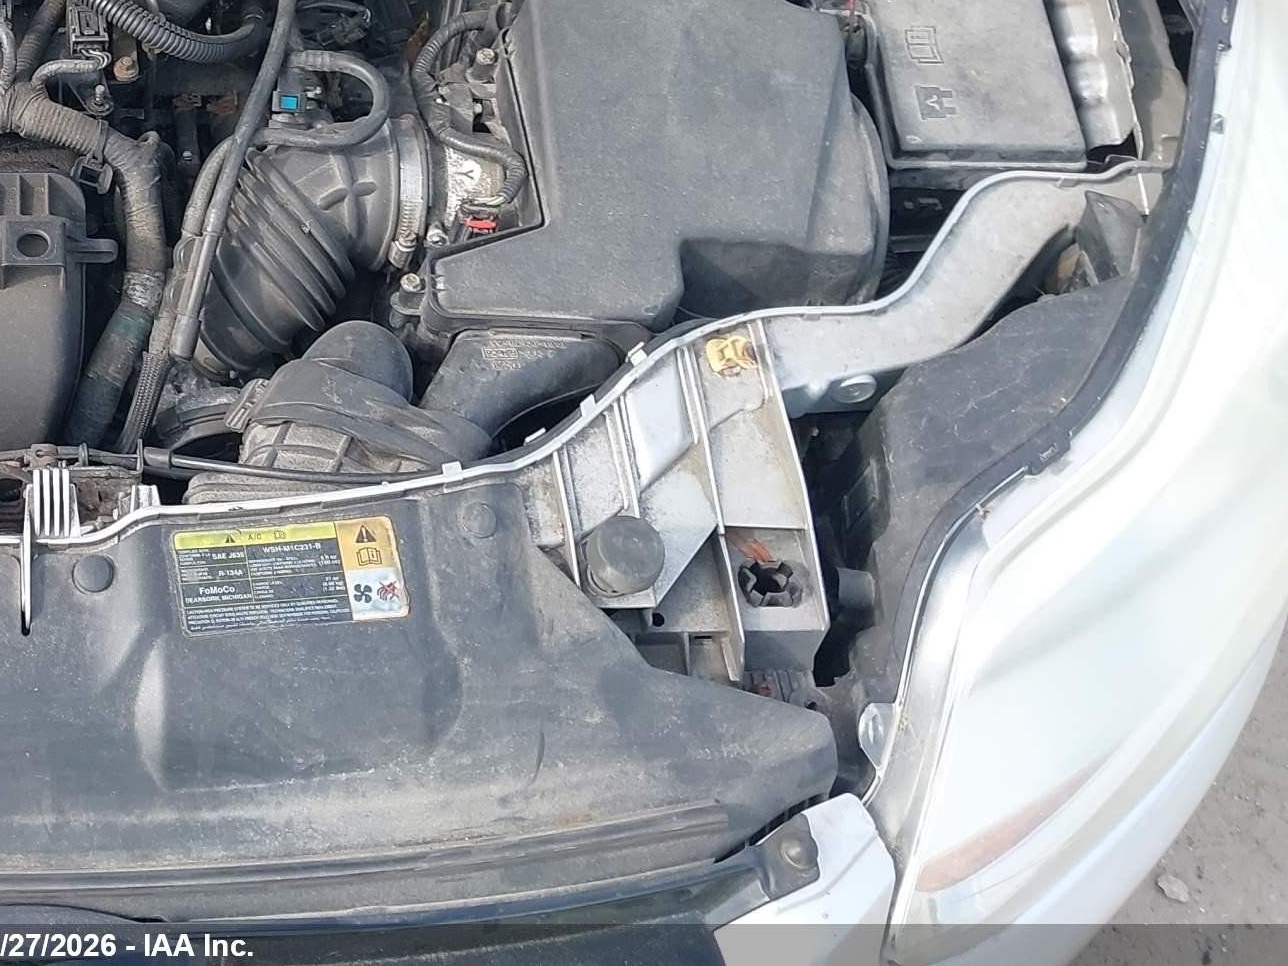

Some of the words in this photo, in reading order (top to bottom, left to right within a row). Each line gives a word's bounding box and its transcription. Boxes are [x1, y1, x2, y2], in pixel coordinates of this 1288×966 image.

[248, 533, 262, 541] A/C
[211, 552, 227, 560] SAE
[218, 569, 243, 577] R-134A
[198, 585, 236, 595] FoMoCo
